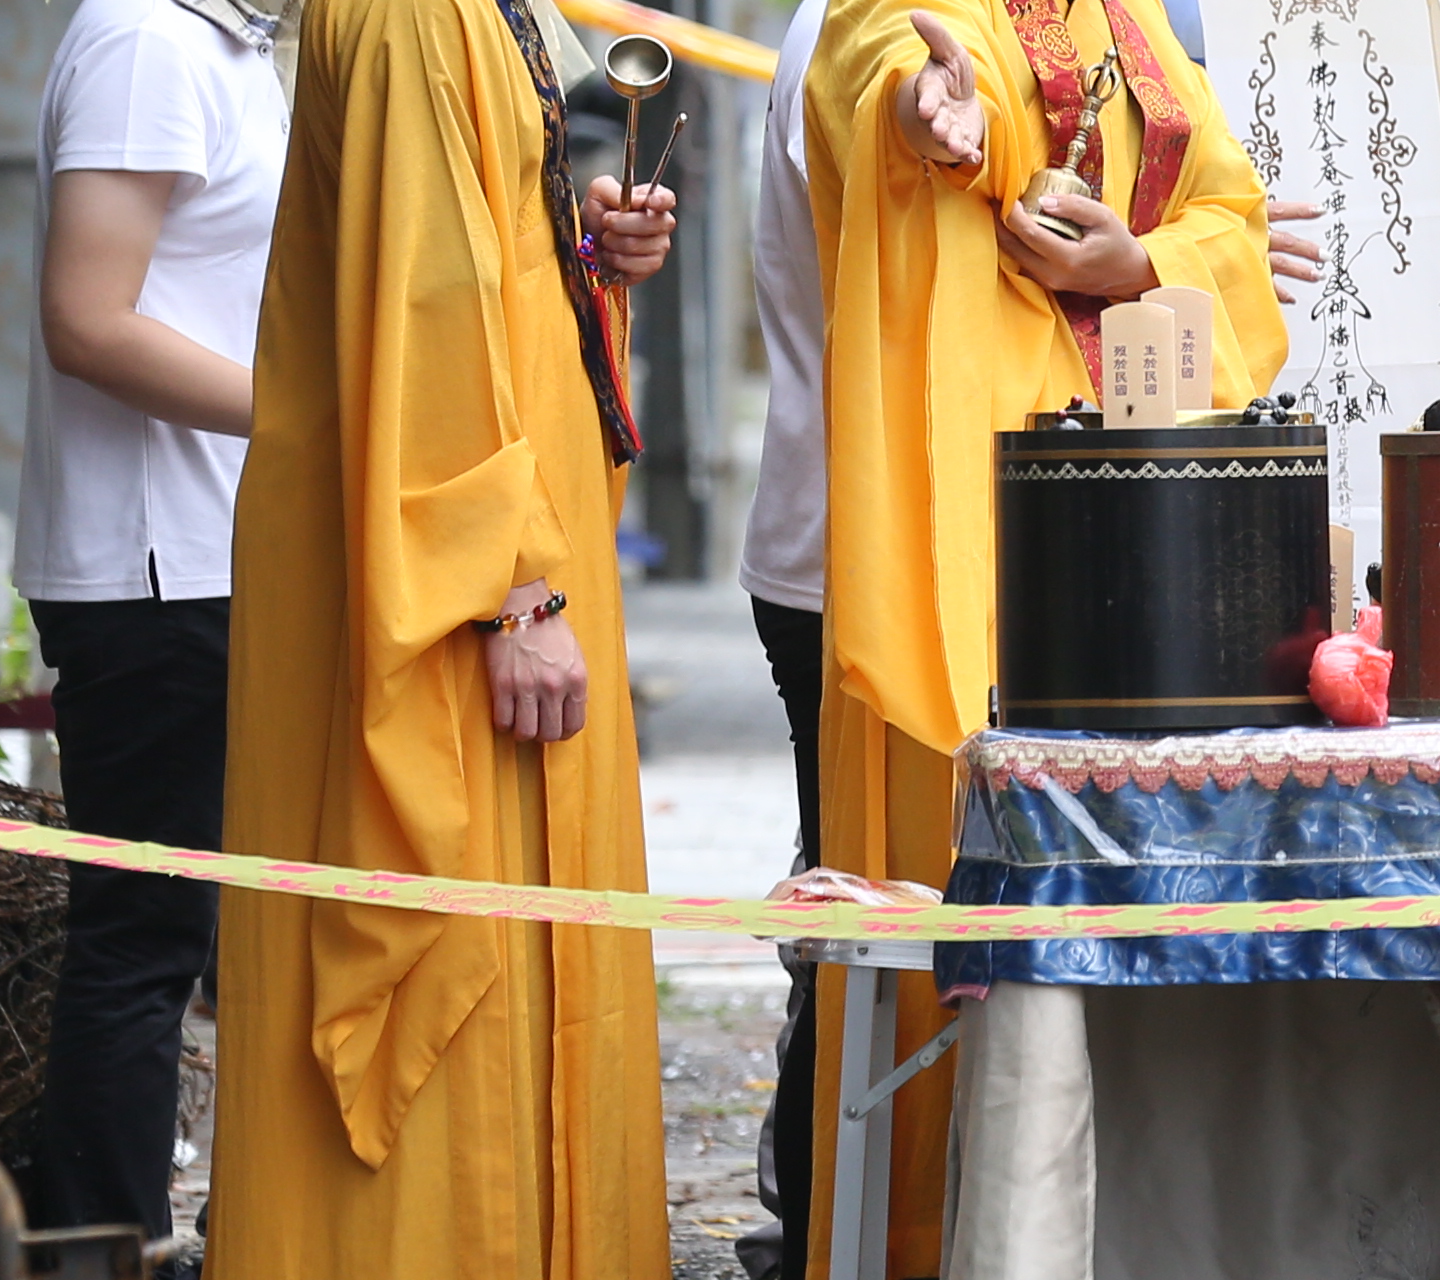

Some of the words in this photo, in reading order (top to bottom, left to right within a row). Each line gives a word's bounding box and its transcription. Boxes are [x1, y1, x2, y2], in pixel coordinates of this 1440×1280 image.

[1143, 345, 1158, 395] 生於民國
[1181, 328, 1195, 379] 生於民國
